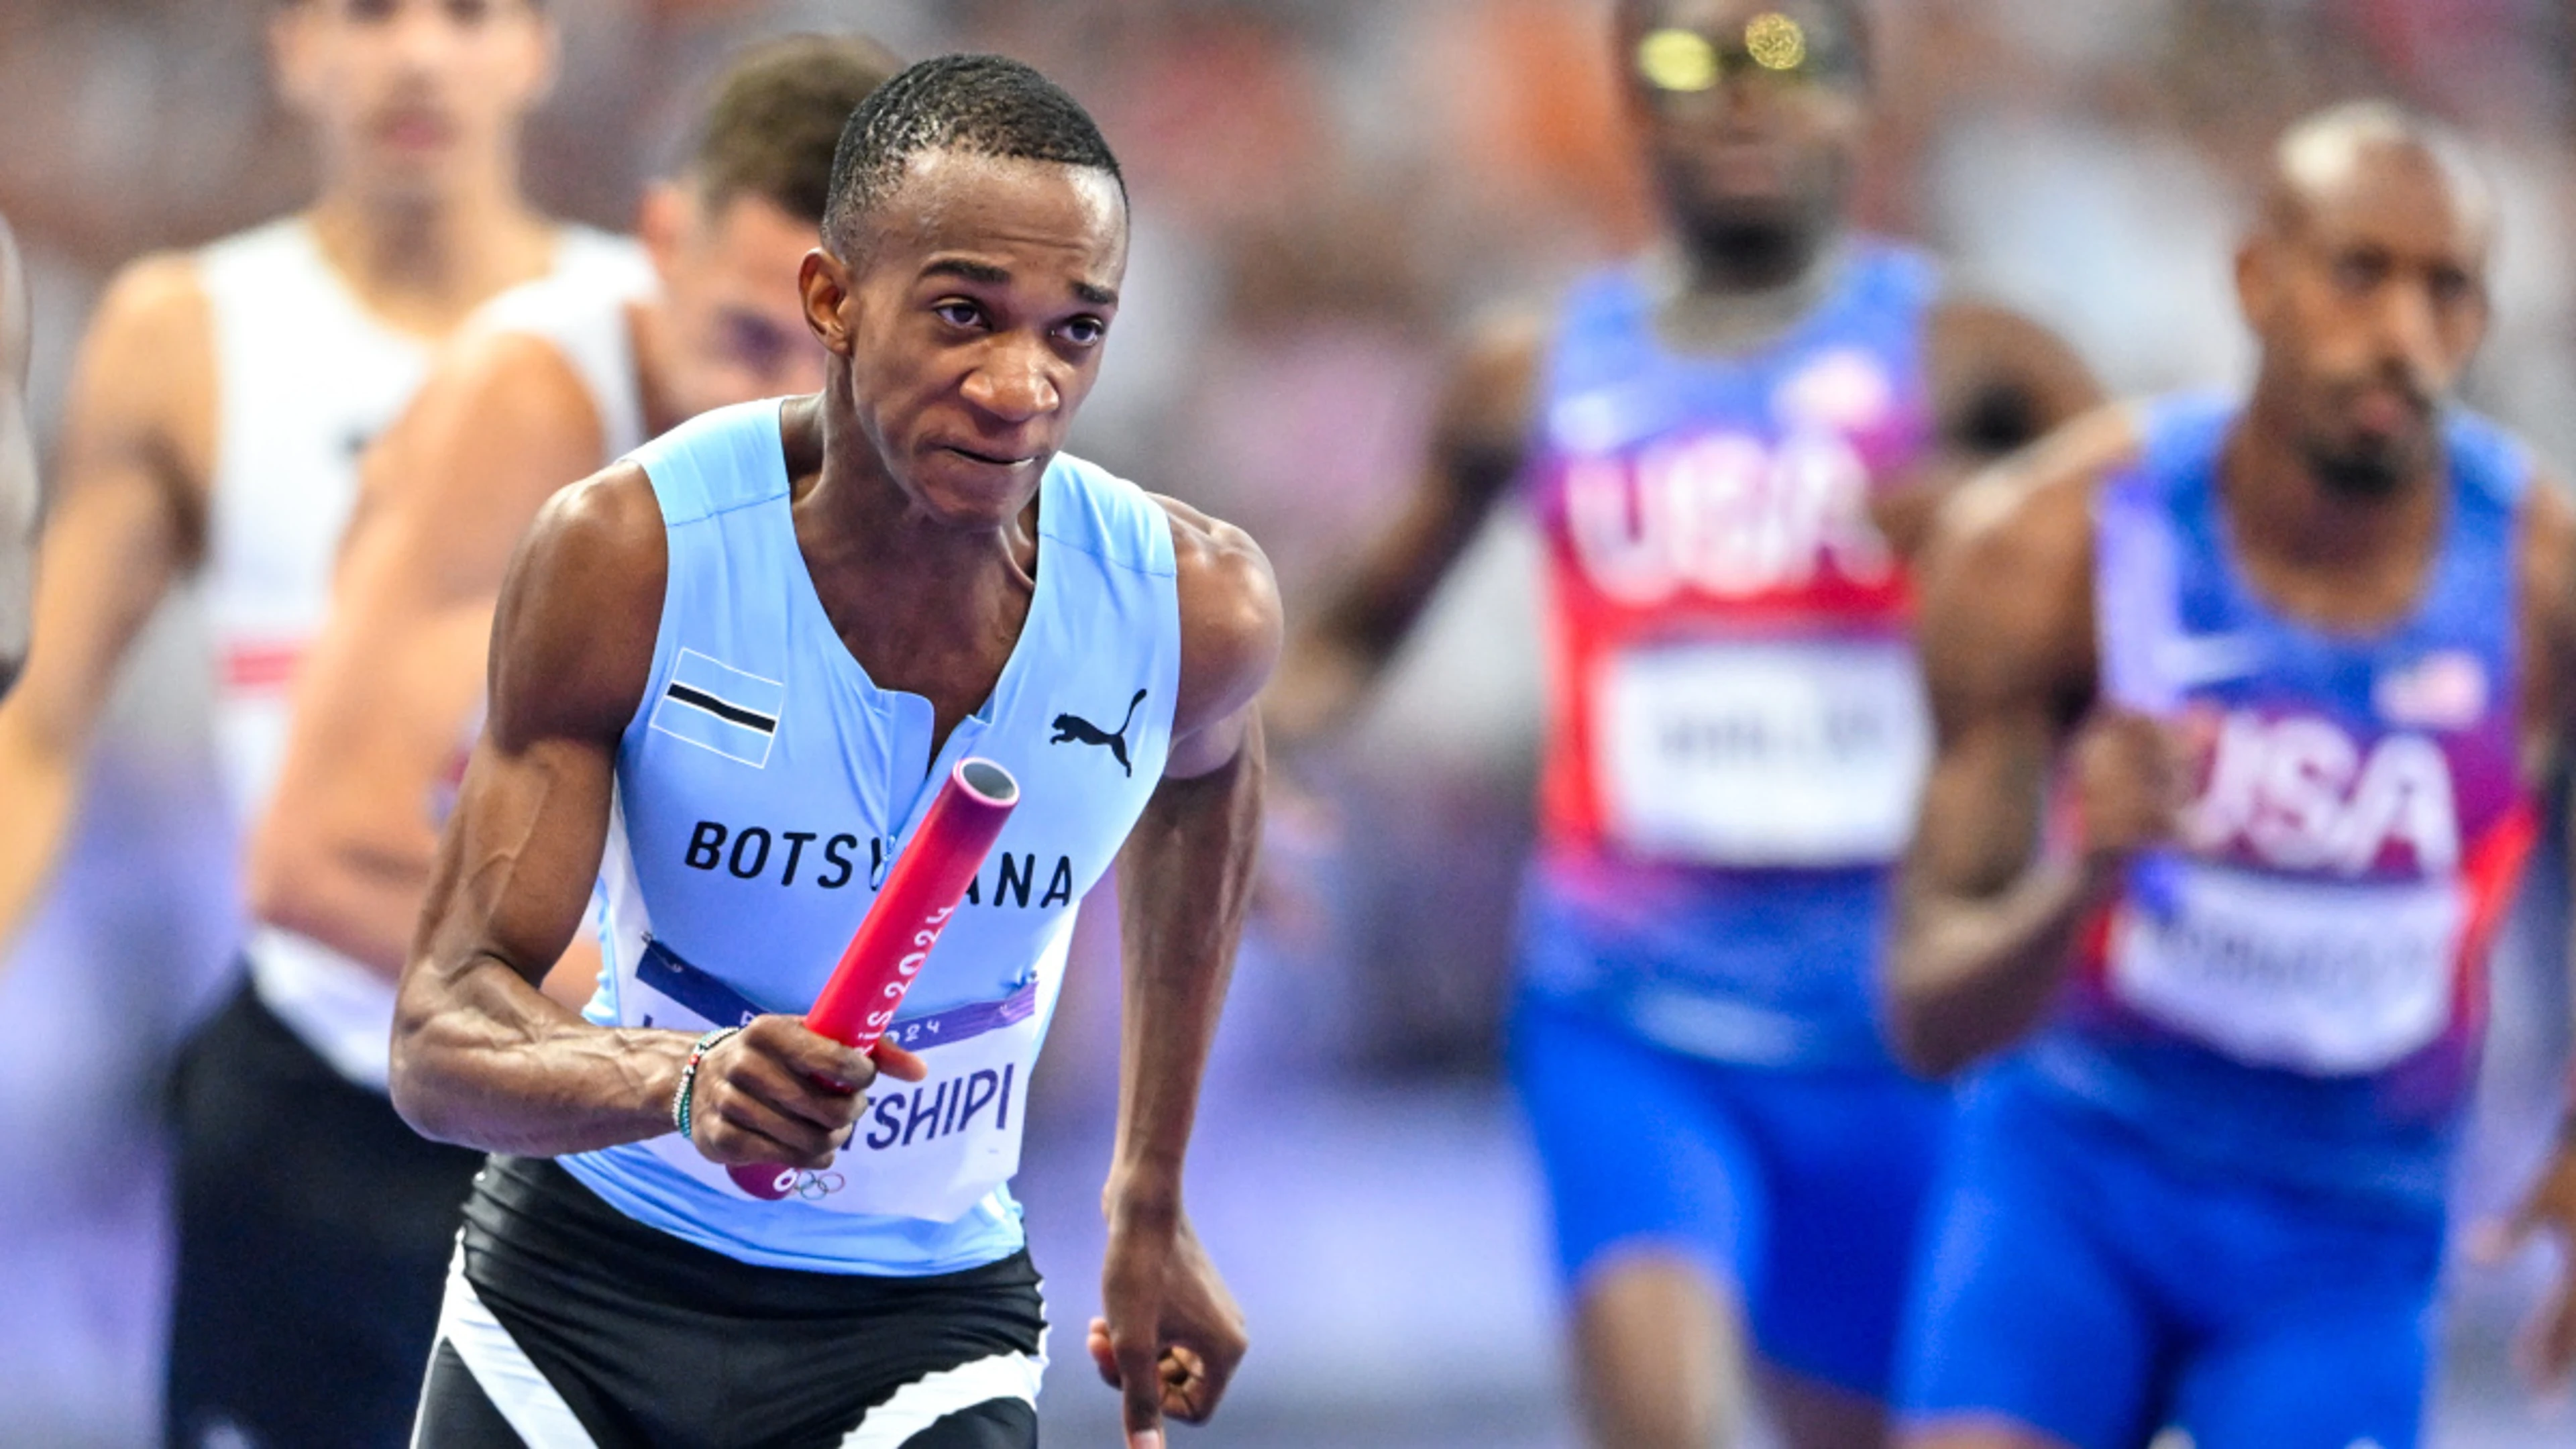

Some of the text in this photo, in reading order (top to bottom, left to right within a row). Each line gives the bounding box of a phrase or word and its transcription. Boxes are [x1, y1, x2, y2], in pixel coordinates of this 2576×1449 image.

[1564, 433, 1894, 605] USA
[684, 821, 1073, 908] BOTSNA
[883, 906, 955, 998] 2024
